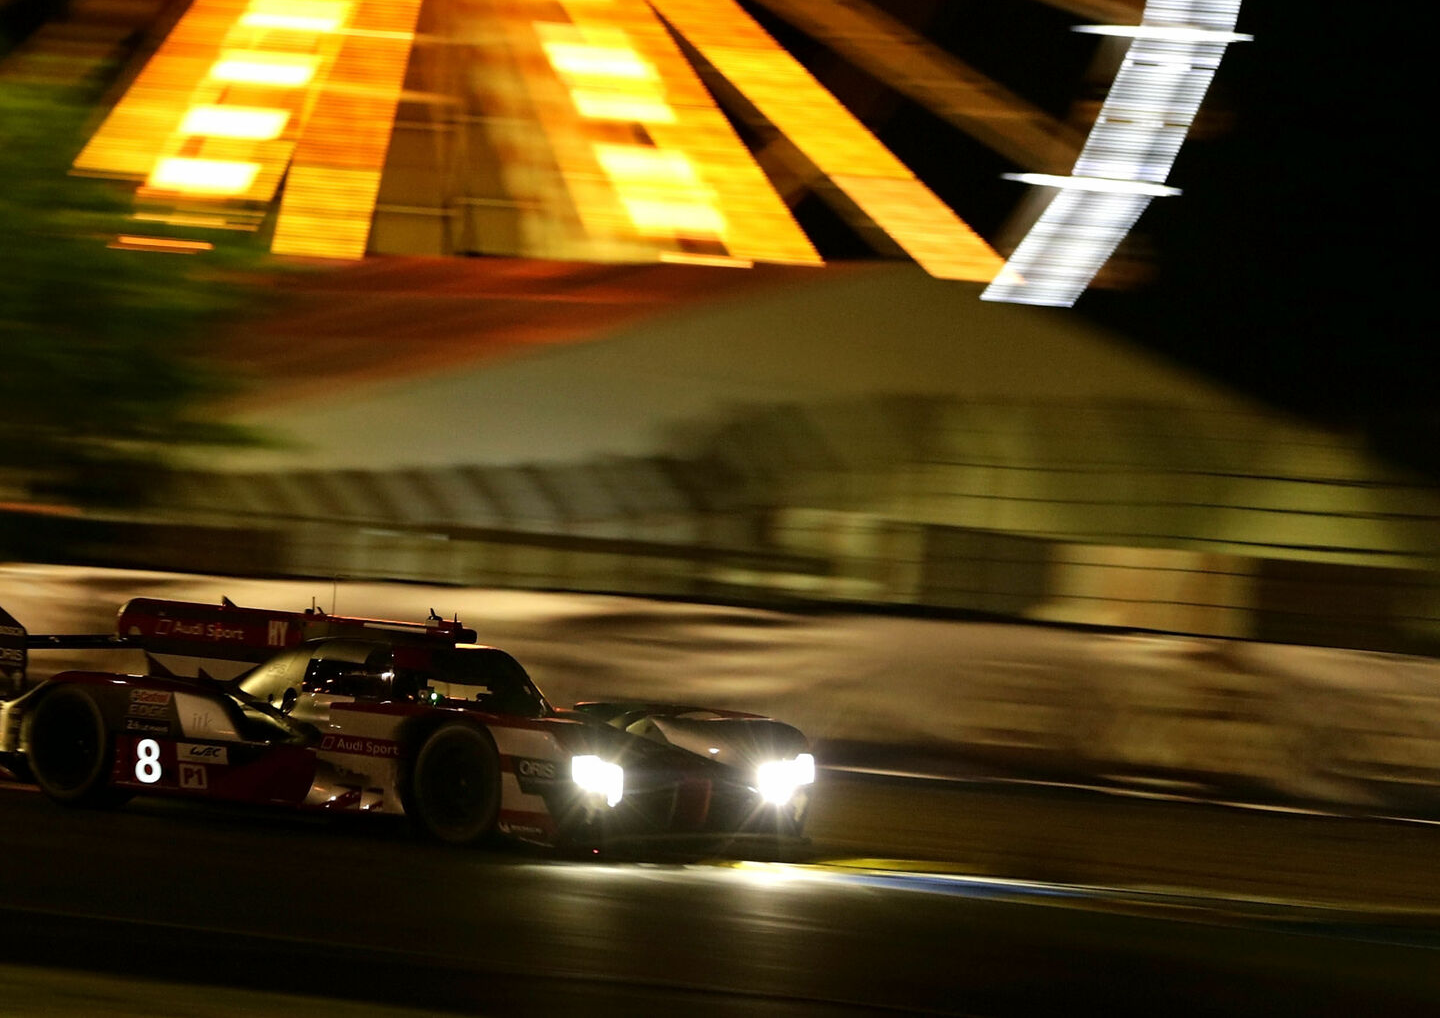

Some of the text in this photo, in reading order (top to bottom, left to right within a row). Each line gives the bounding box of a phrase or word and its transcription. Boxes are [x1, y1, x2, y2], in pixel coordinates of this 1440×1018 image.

[174, 620, 246, 641] Audi Sport
[268, 620, 289, 646] HY
[129, 703, 168, 717] EDGE
[190, 746, 222, 757] WEC
[337, 738, 400, 756] Audi Sport
[135, 738, 162, 784] 8
[520, 760, 556, 779] ORIS
[183, 767, 204, 785] P1
